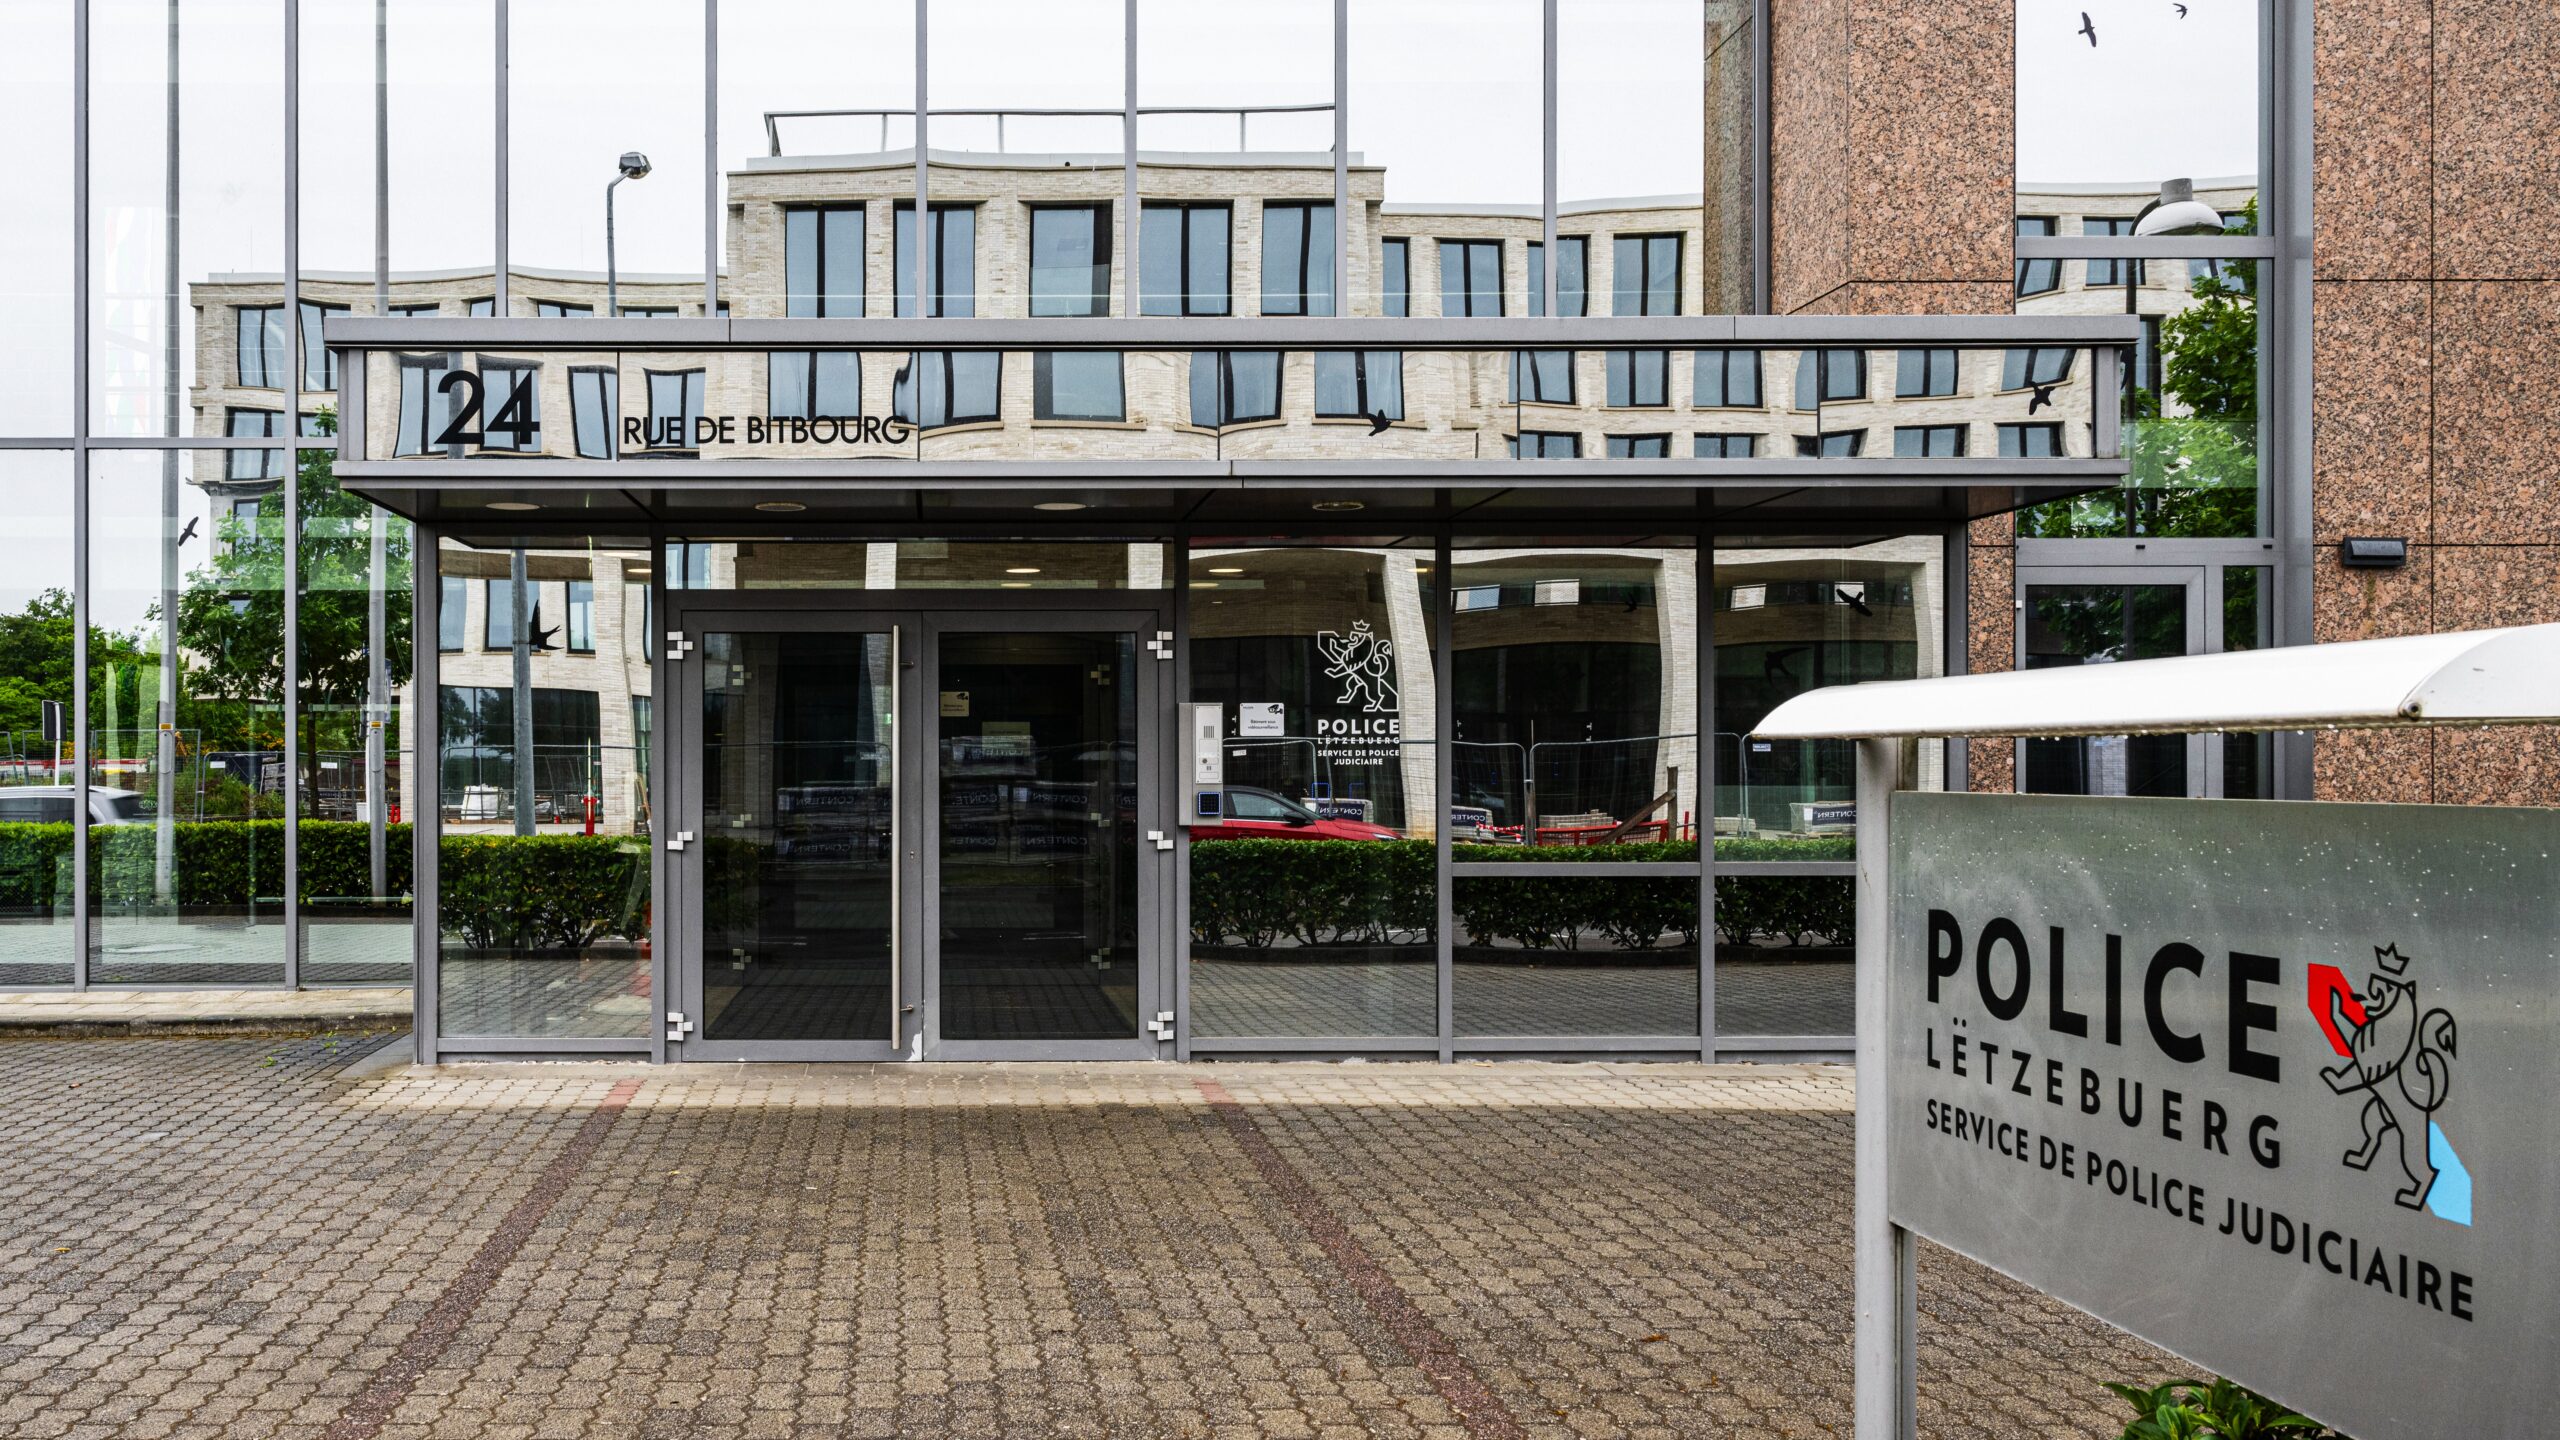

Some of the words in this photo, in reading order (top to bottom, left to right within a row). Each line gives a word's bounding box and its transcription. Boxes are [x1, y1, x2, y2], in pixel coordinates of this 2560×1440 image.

[434, 369, 540, 445] 24
[624, 416, 682, 445] RUE
[697, 416, 735, 445] DE
[748, 415, 910, 445] BITBOURG
[1317, 718, 1400, 735] POLICE
[1317, 735, 1400, 745] LËTZEBUERG
[1317, 749, 1353, 757] SERVICE
[1355, 749, 1367, 757] DE
[1368, 749, 1400, 757] POLICE
[1334, 758, 1383, 766] JUDICIAIRE
[1927, 908, 2281, 1084] POLICE
[1926, 1016, 2281, 1169] LËTZEBUERG
[1926, 1098, 2029, 1163] SERVICE
[2040, 1135, 2075, 1179] DE
[2086, 1151, 2205, 1226] POLICE
[2218, 1197, 2474, 1323] JUDICIAIRE
